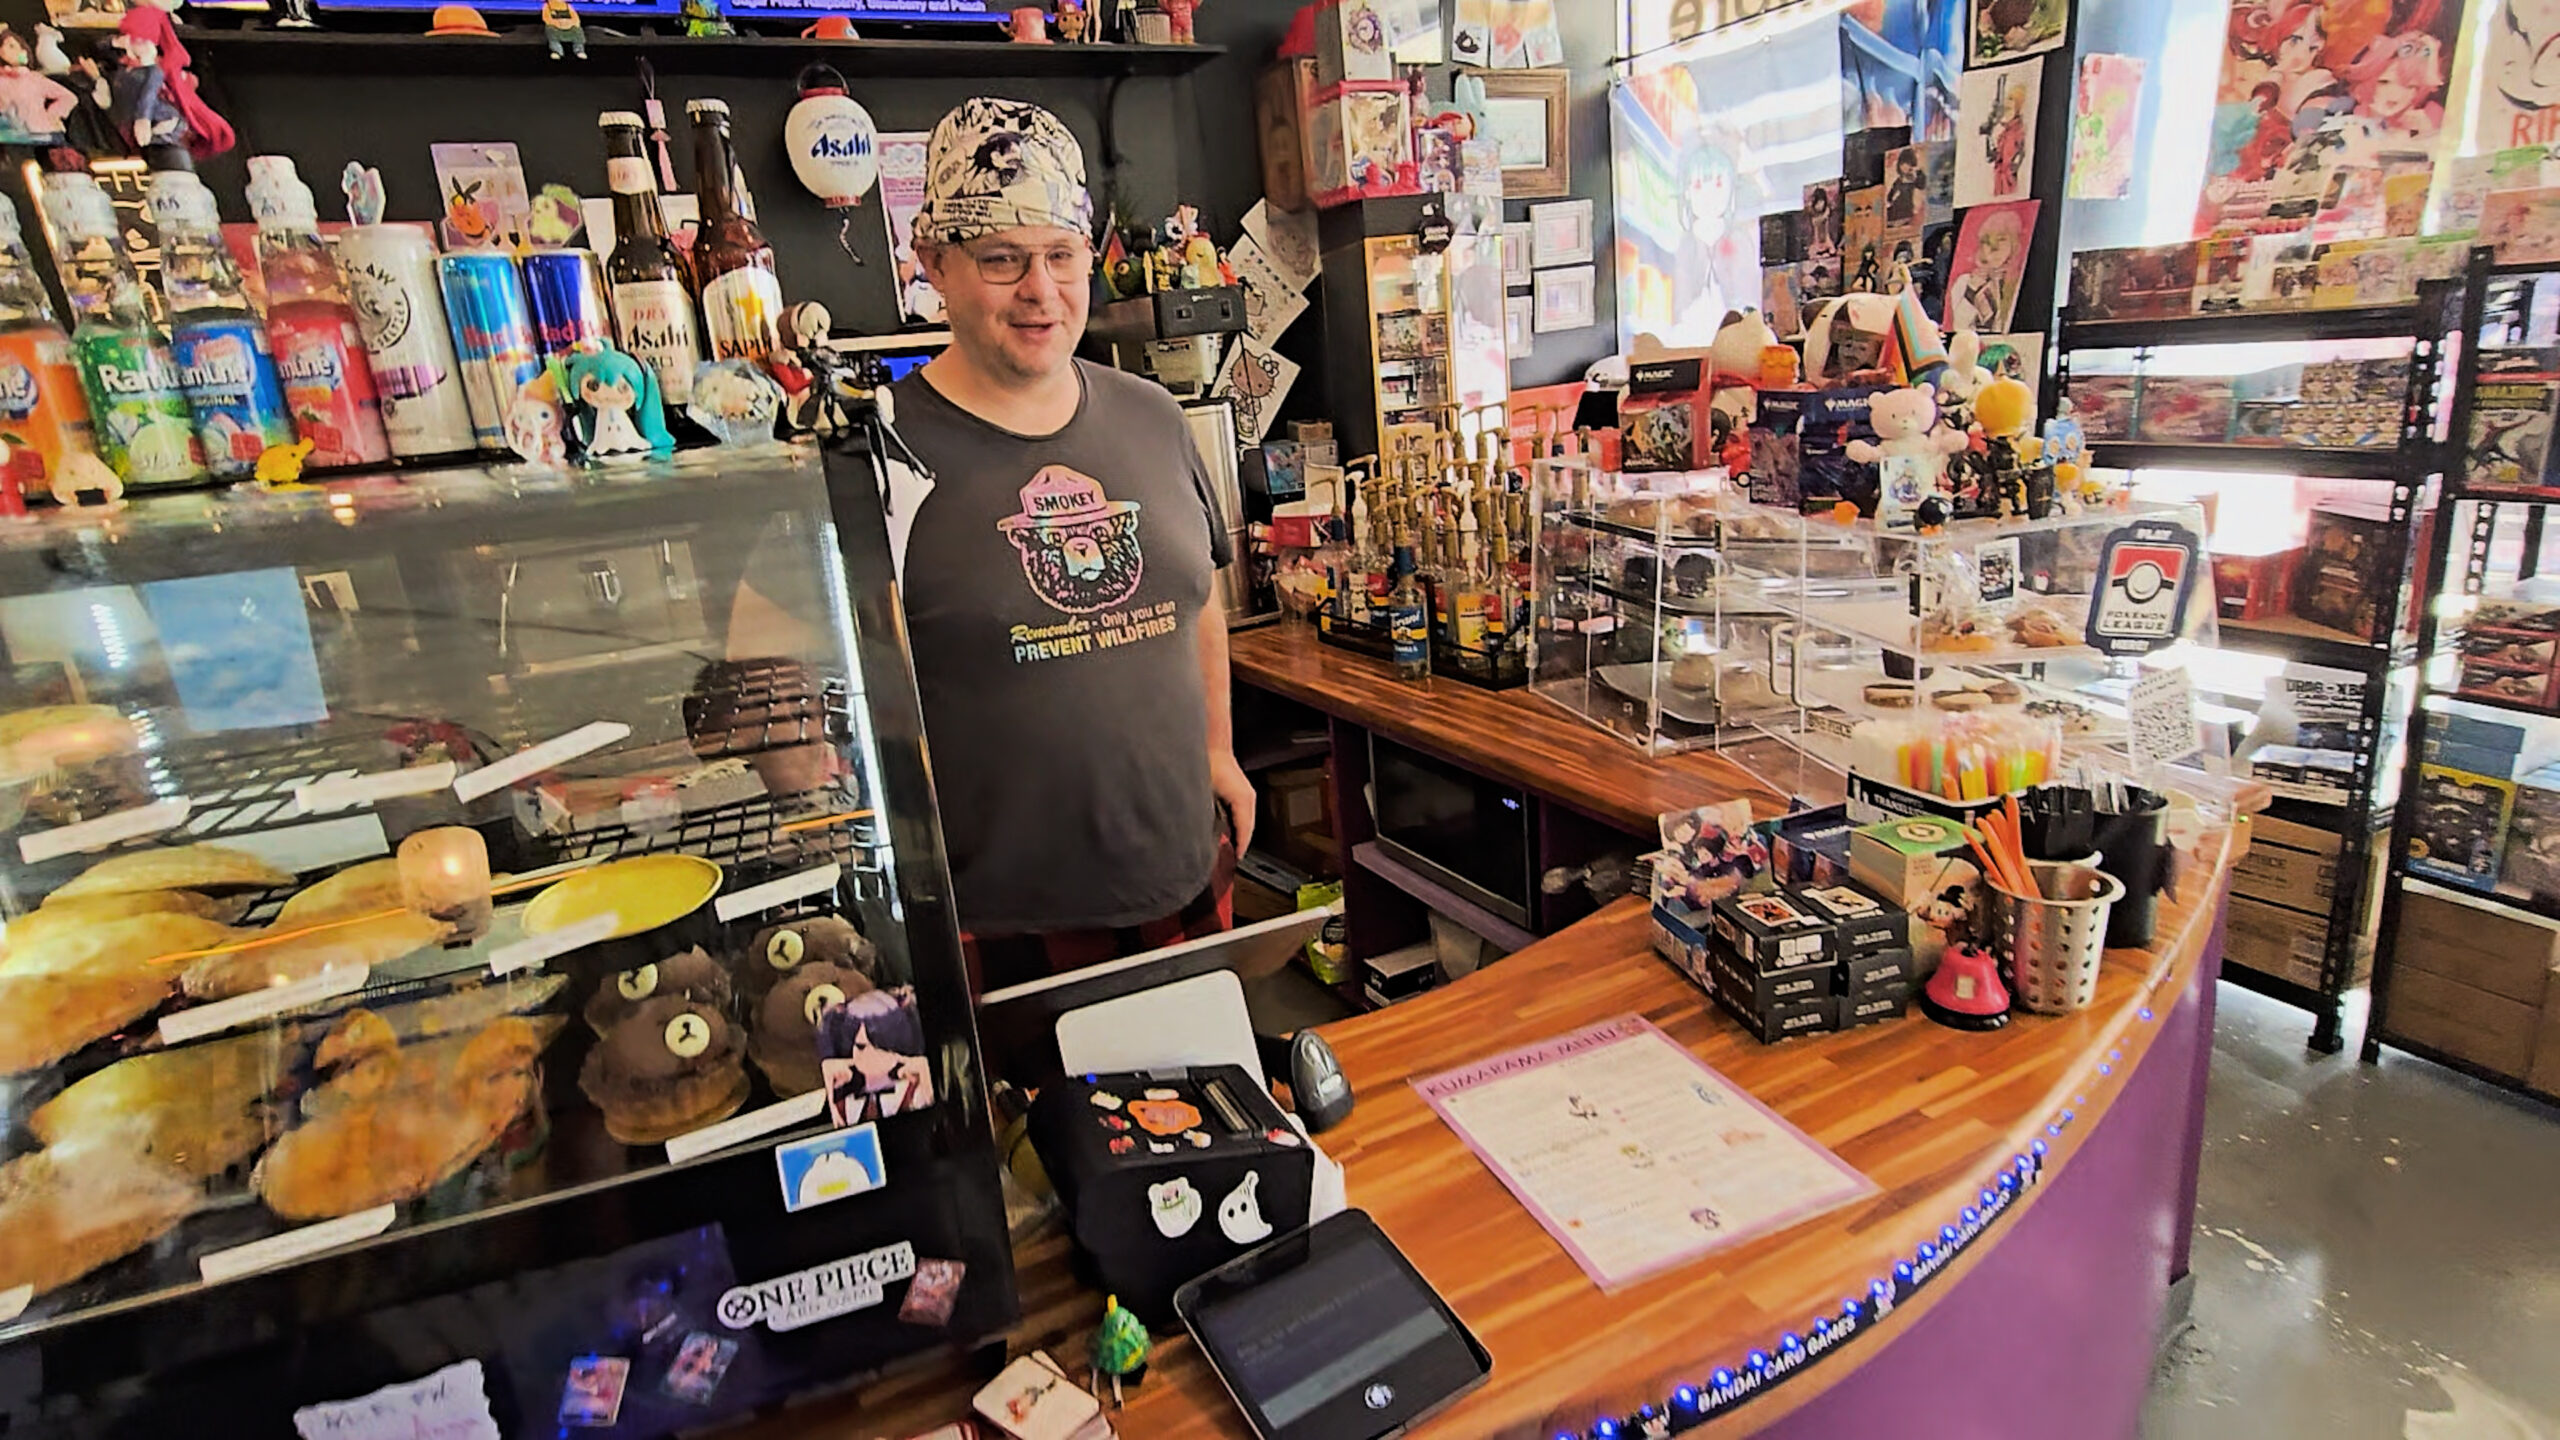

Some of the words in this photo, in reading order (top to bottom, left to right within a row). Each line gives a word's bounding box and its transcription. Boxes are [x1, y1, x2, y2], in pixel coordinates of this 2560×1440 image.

[811, 132, 872, 158] Asahi
[628, 323, 690, 350] Asahi
[1643, 369, 1674, 379] MAGIC
[1837, 398, 1870, 409] MAGI
[1034, 491, 1095, 511] SMOKEY
[1101, 610, 1128, 628] Only
[1130, 606, 1154, 622] you
[1156, 600, 1176, 616] can
[2102, 620, 2166, 631] LEAGUE
[1014, 635, 1093, 664] PREVENT
[1095, 615, 1177, 649] WILDFIRES
[724, 1281, 807, 1322] ONE
[815, 1248, 909, 1297] PIECE
[1697, 1368, 1762, 1414] BANDAI
[1763, 1343, 1807, 1381] CARD
[1806, 1315, 1857, 1358] GAMES
